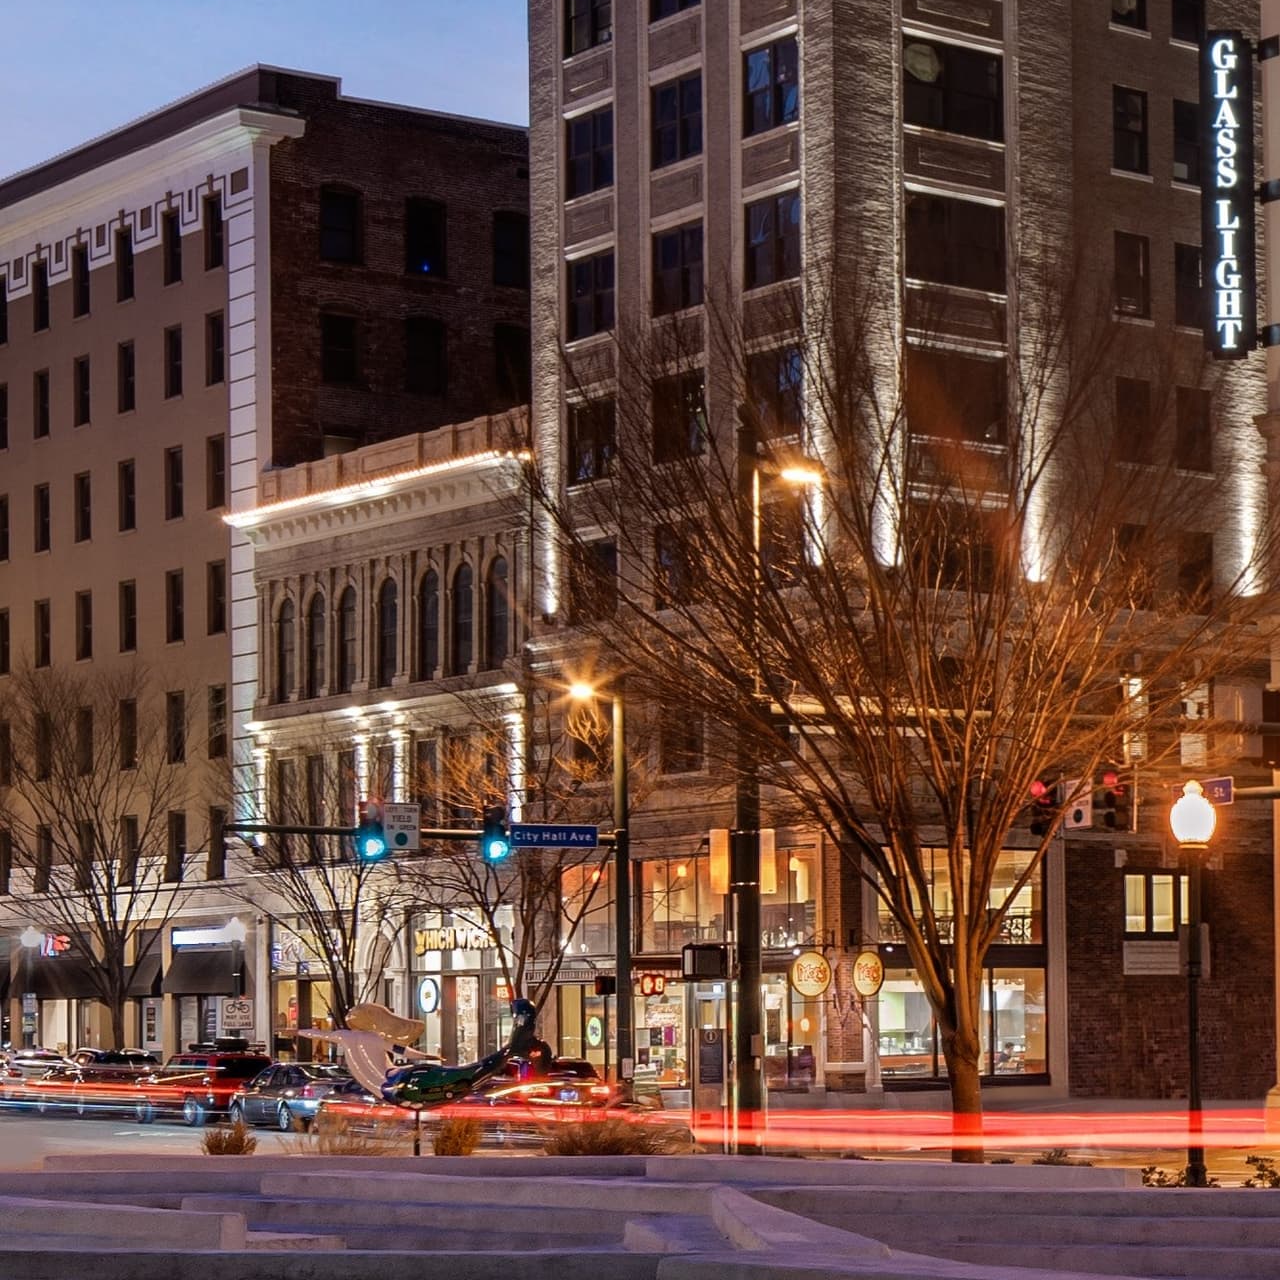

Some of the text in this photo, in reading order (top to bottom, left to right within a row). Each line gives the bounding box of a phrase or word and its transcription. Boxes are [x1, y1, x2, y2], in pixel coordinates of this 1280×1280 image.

[1211, 38, 1242, 349] GLASS LIGHT
[513, 831, 593, 842] City Hall Ave.
[415, 925, 455, 956] WHICH
